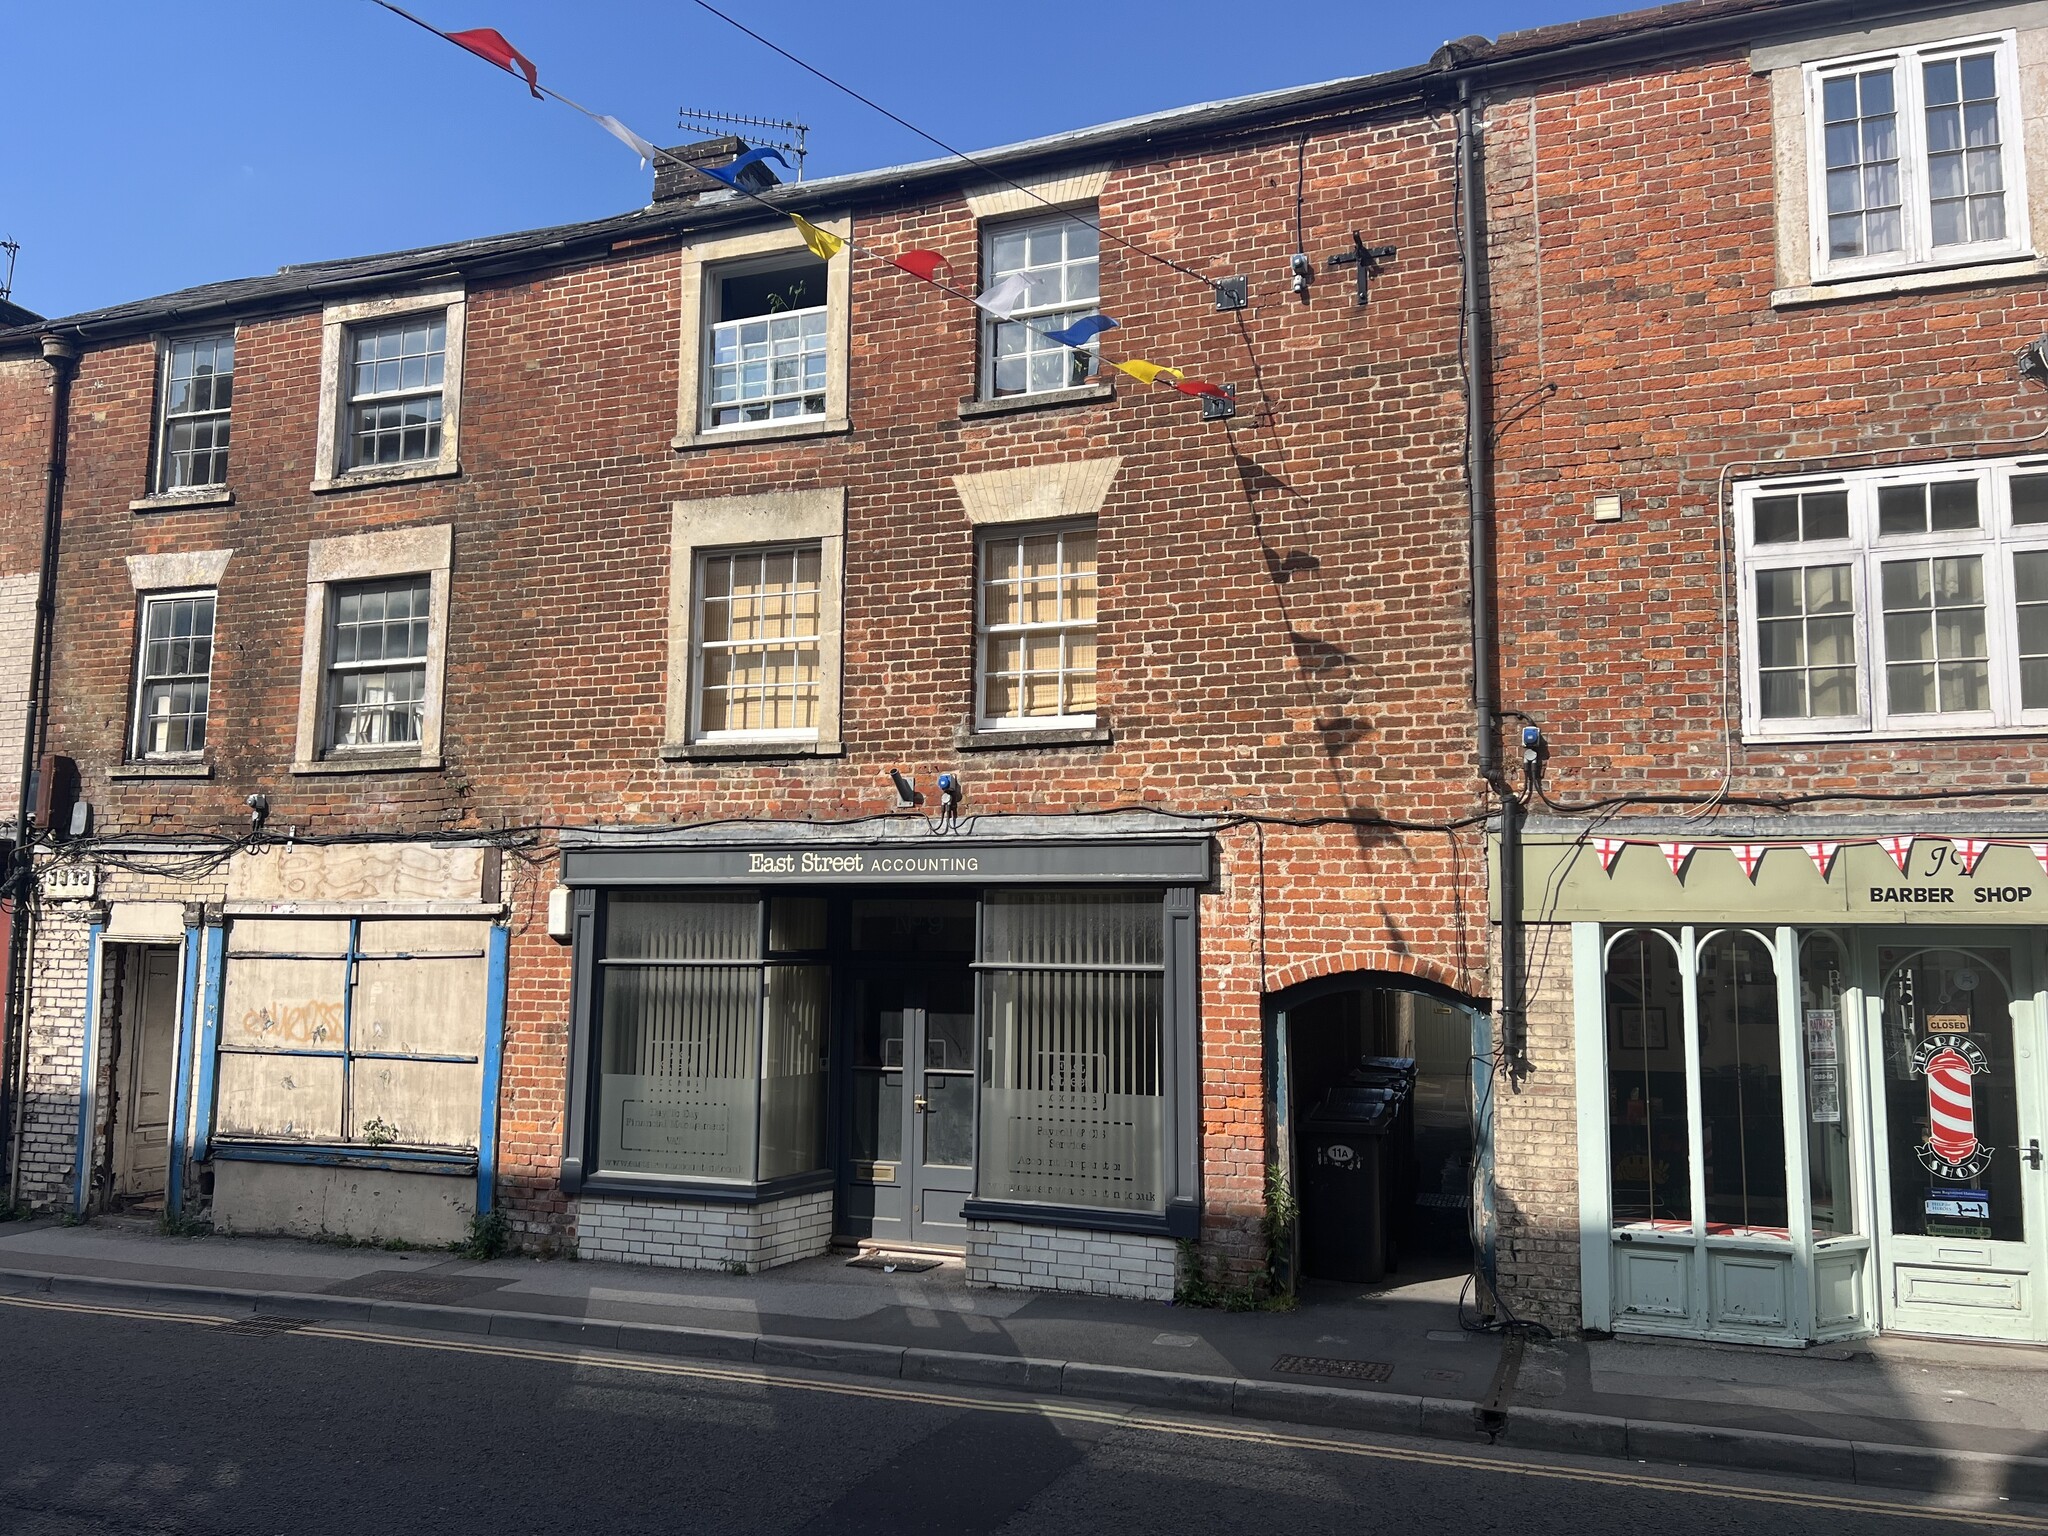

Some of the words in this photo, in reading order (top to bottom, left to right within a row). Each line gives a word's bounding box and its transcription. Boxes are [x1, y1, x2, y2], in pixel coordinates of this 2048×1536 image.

[749, 853, 795, 873] East
[801, 852, 864, 873] Street
[871, 858, 978, 871] ACCOUNTING
[1870, 887, 1954, 903] BARBER
[1973, 886, 2032, 903] SHOP
[1914, 1036, 1983, 1062] BARBER
[1332, 1148, 1349, 1158] 11A
[1929, 1160, 1980, 1178] SHOP
[1929, 1225, 1965, 1234] Warminster
[1965, 1227, 1978, 1235] RFC
